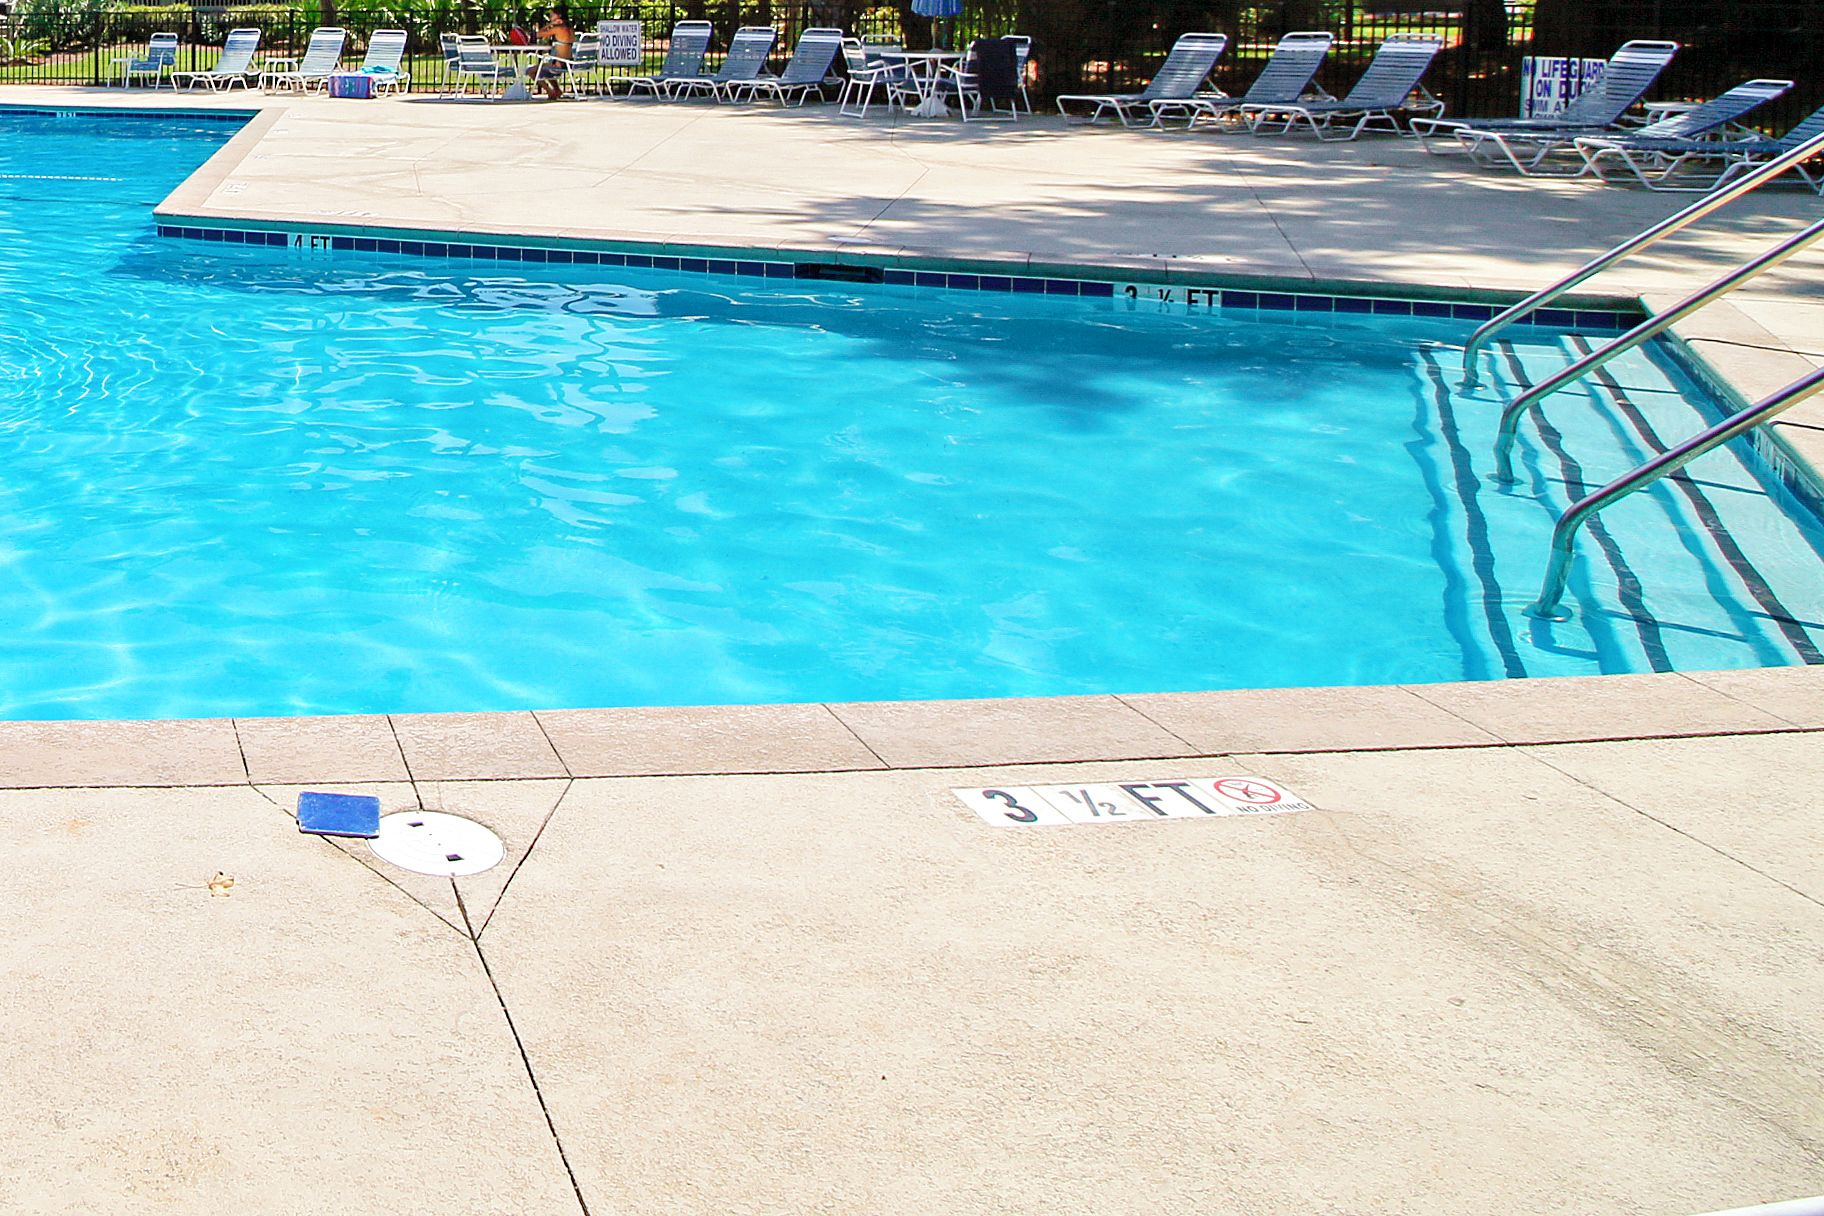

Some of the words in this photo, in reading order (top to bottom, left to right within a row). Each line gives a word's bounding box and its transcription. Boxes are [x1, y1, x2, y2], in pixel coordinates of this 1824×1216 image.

[612, 35, 638, 47] DIVING
[601, 48, 637, 60] ALLOWED
[1537, 79, 1551, 97] ON
[310, 235, 330, 249] FT
[1187, 288, 1219, 307] FT
[981, 788, 1038, 823] 3
[1118, 781, 1216, 817] FT
[1236, 804, 1258, 814] NO
[1259, 802, 1310, 812] DIVING
